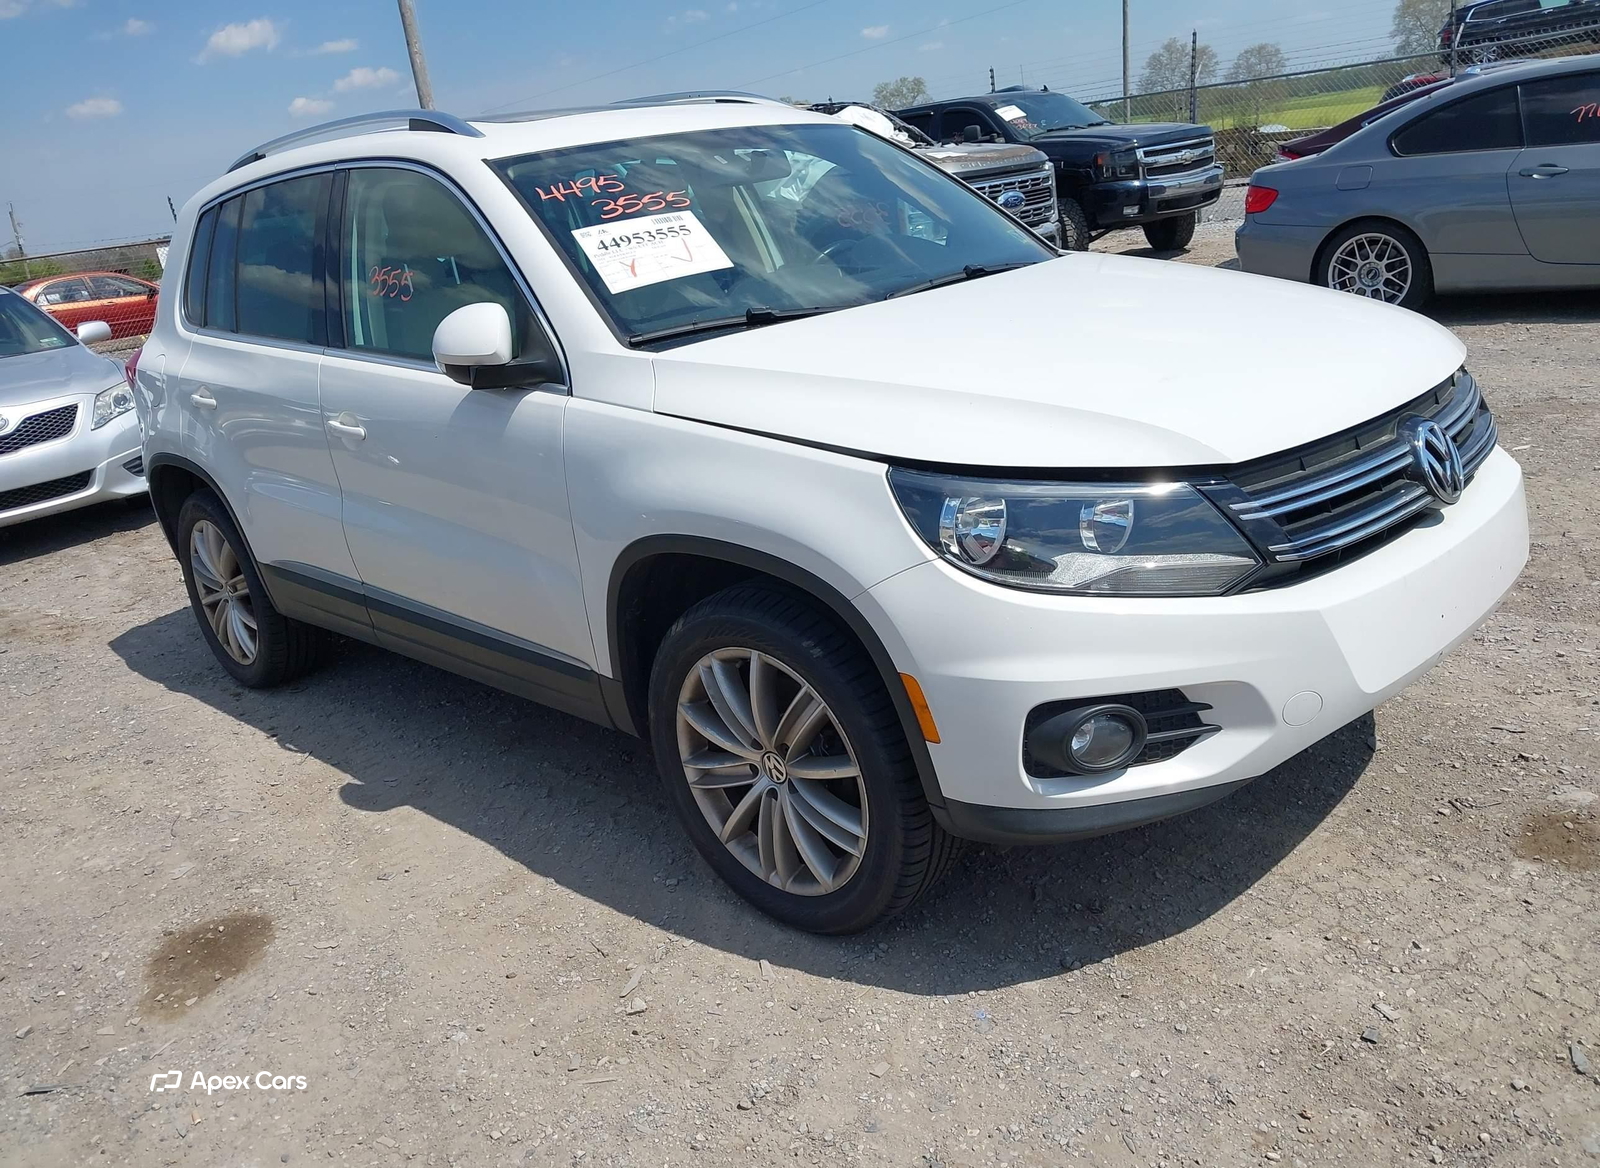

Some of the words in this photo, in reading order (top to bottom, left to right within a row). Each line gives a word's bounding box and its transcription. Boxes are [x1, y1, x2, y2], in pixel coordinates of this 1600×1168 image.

[1570, 103, 1600, 122] 77
[535, 174, 625, 202] 4495
[591, 190, 691, 219] 3555
[597, 224, 692, 251] 44953555
[369, 265, 414, 302] 3555
